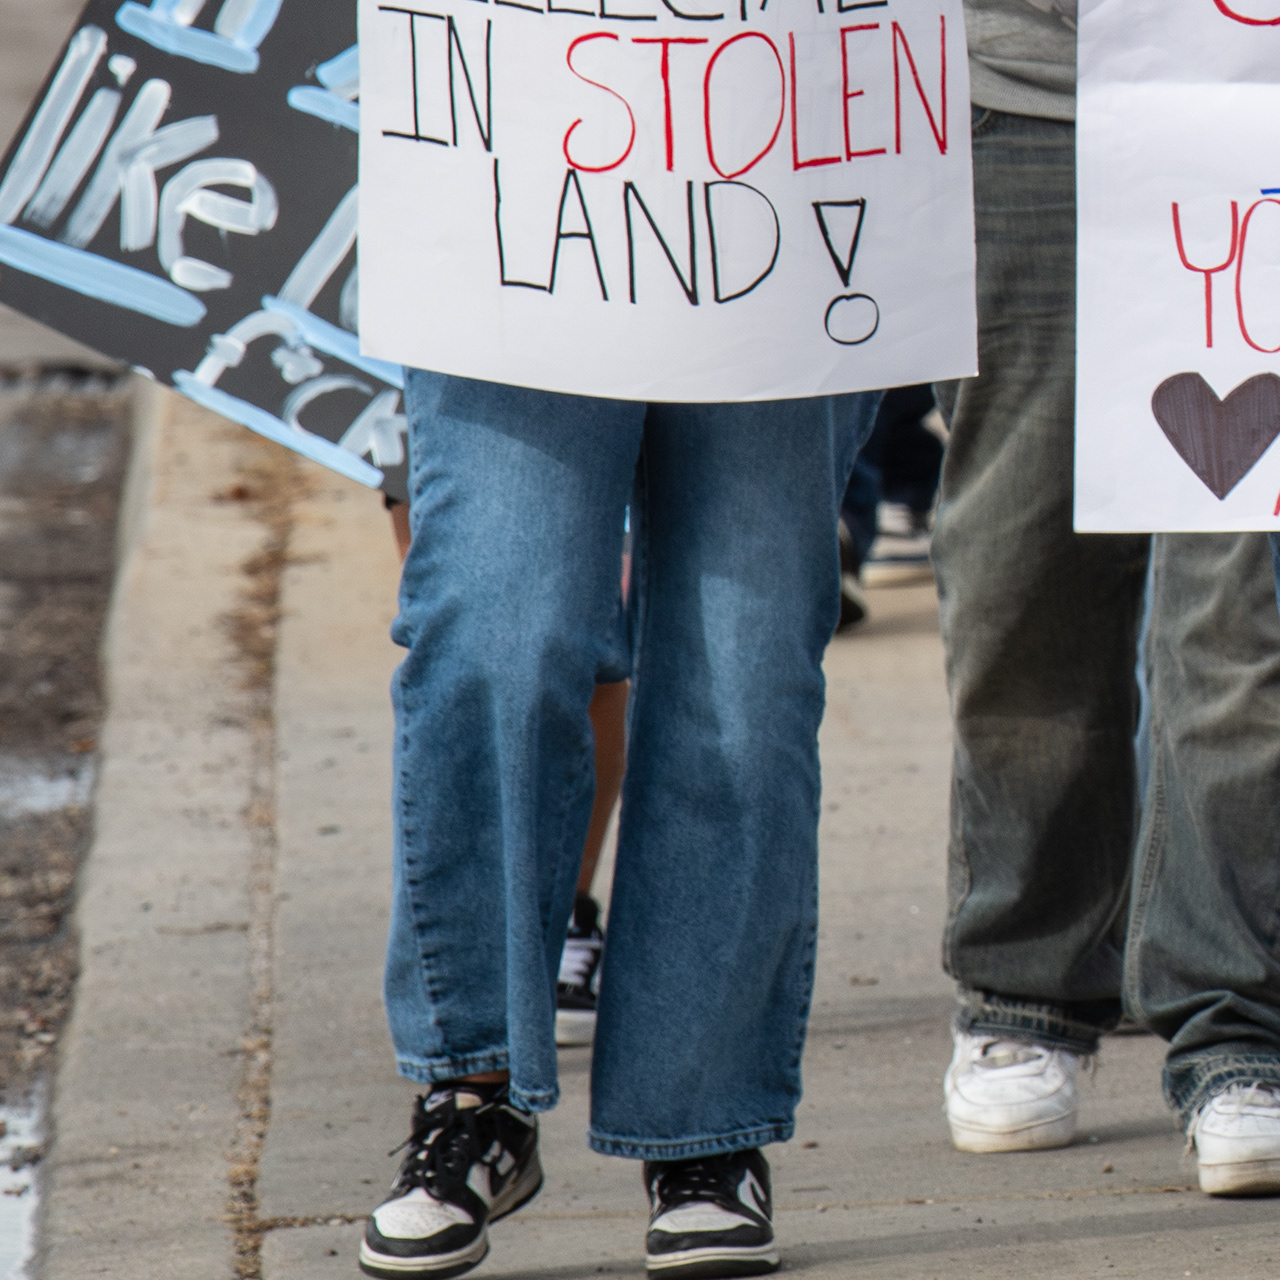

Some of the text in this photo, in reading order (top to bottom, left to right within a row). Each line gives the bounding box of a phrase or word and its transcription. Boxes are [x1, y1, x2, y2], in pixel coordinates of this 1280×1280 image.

[0, 25, 279, 291] like
[377, 5, 947, 180] IN STOLEN
